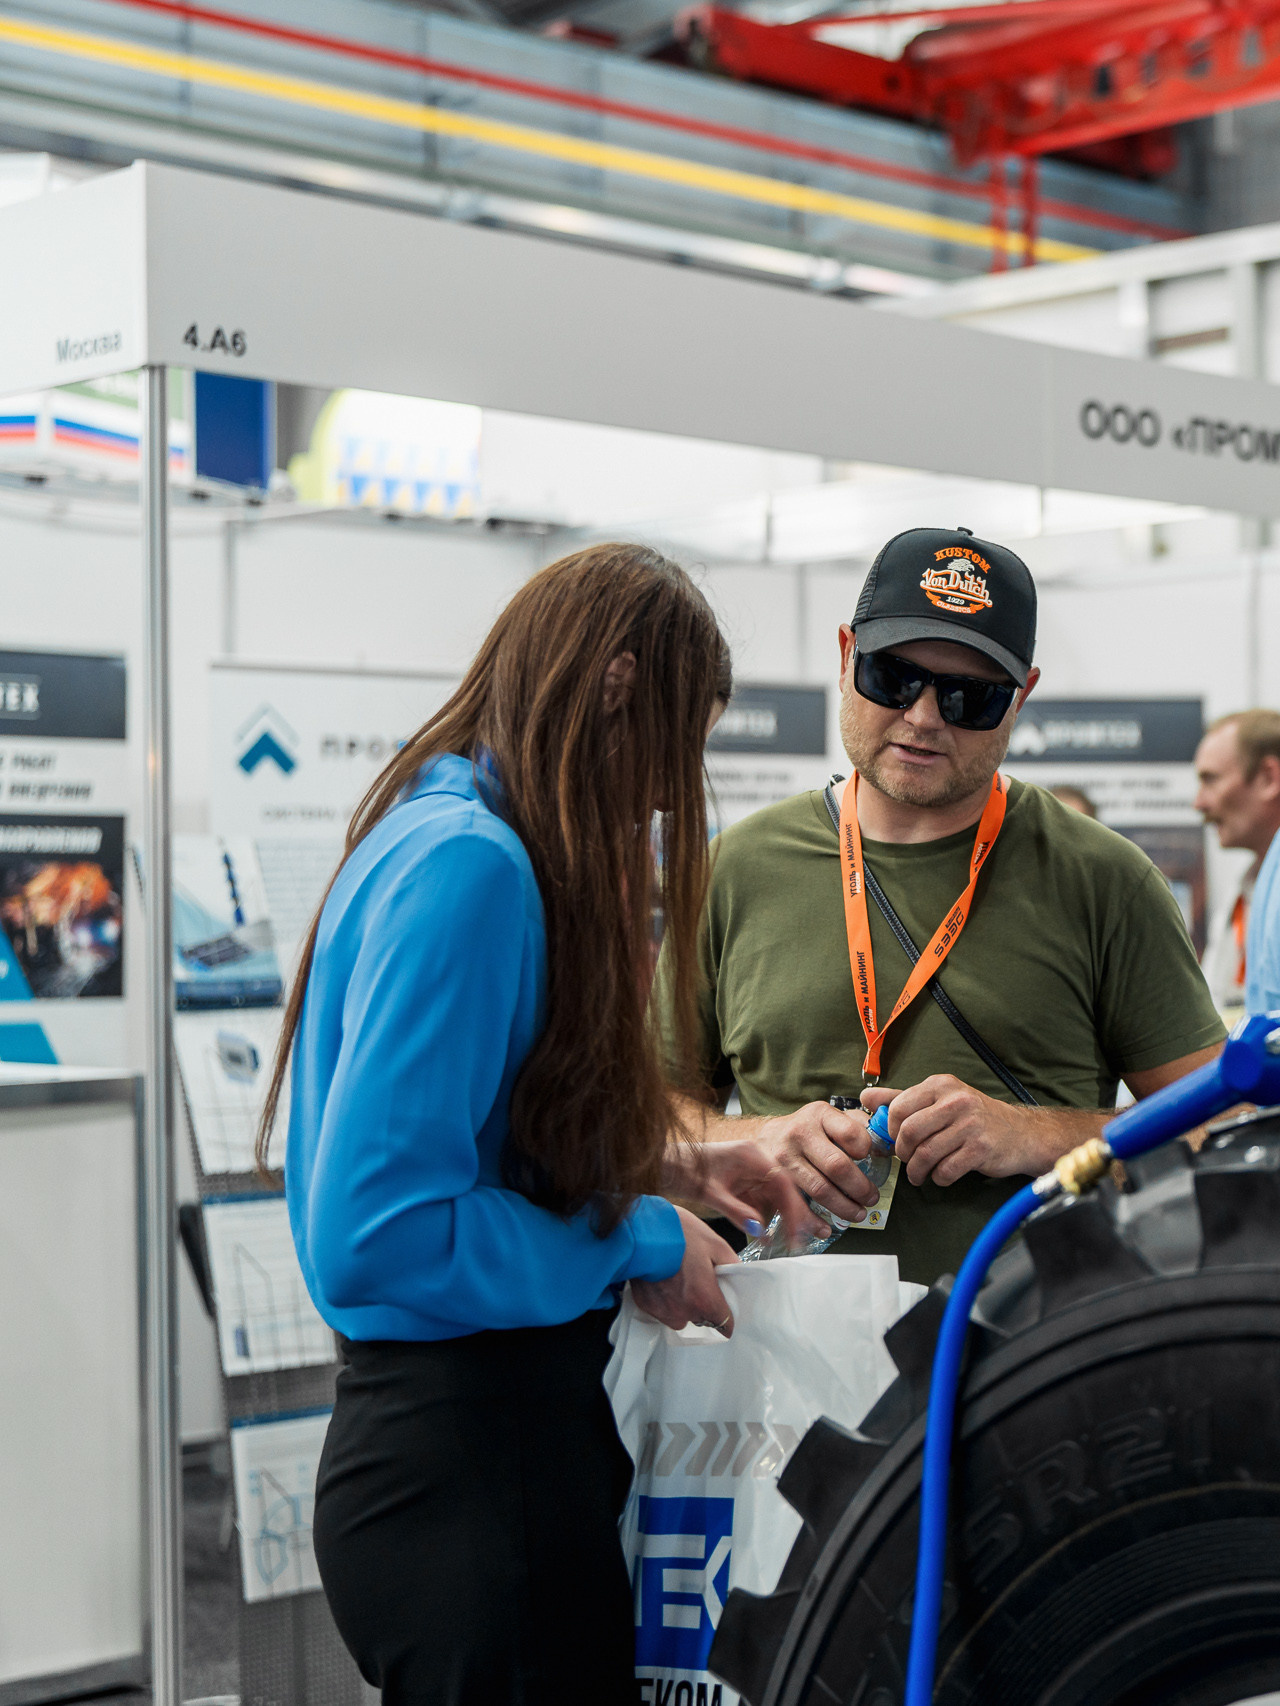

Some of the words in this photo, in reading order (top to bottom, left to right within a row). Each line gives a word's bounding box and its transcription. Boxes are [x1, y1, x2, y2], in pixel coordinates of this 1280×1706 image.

[56, 331, 122, 363] Москва
[1079, 399, 1161, 448] ООО
[933, 546, 992, 574] KUSTOM
[921, 567, 948, 590] Von
[944, 569, 991, 603] Dutch
[945, 596, 966, 606] 1929
[845, 823, 856, 861] МАЙНИНГ
[848, 870, 858, 898] УГОЛЬ
[856, 950, 869, 995] МАЙНИНГ
[634, 1678, 723, 1706] ЕКОМ
